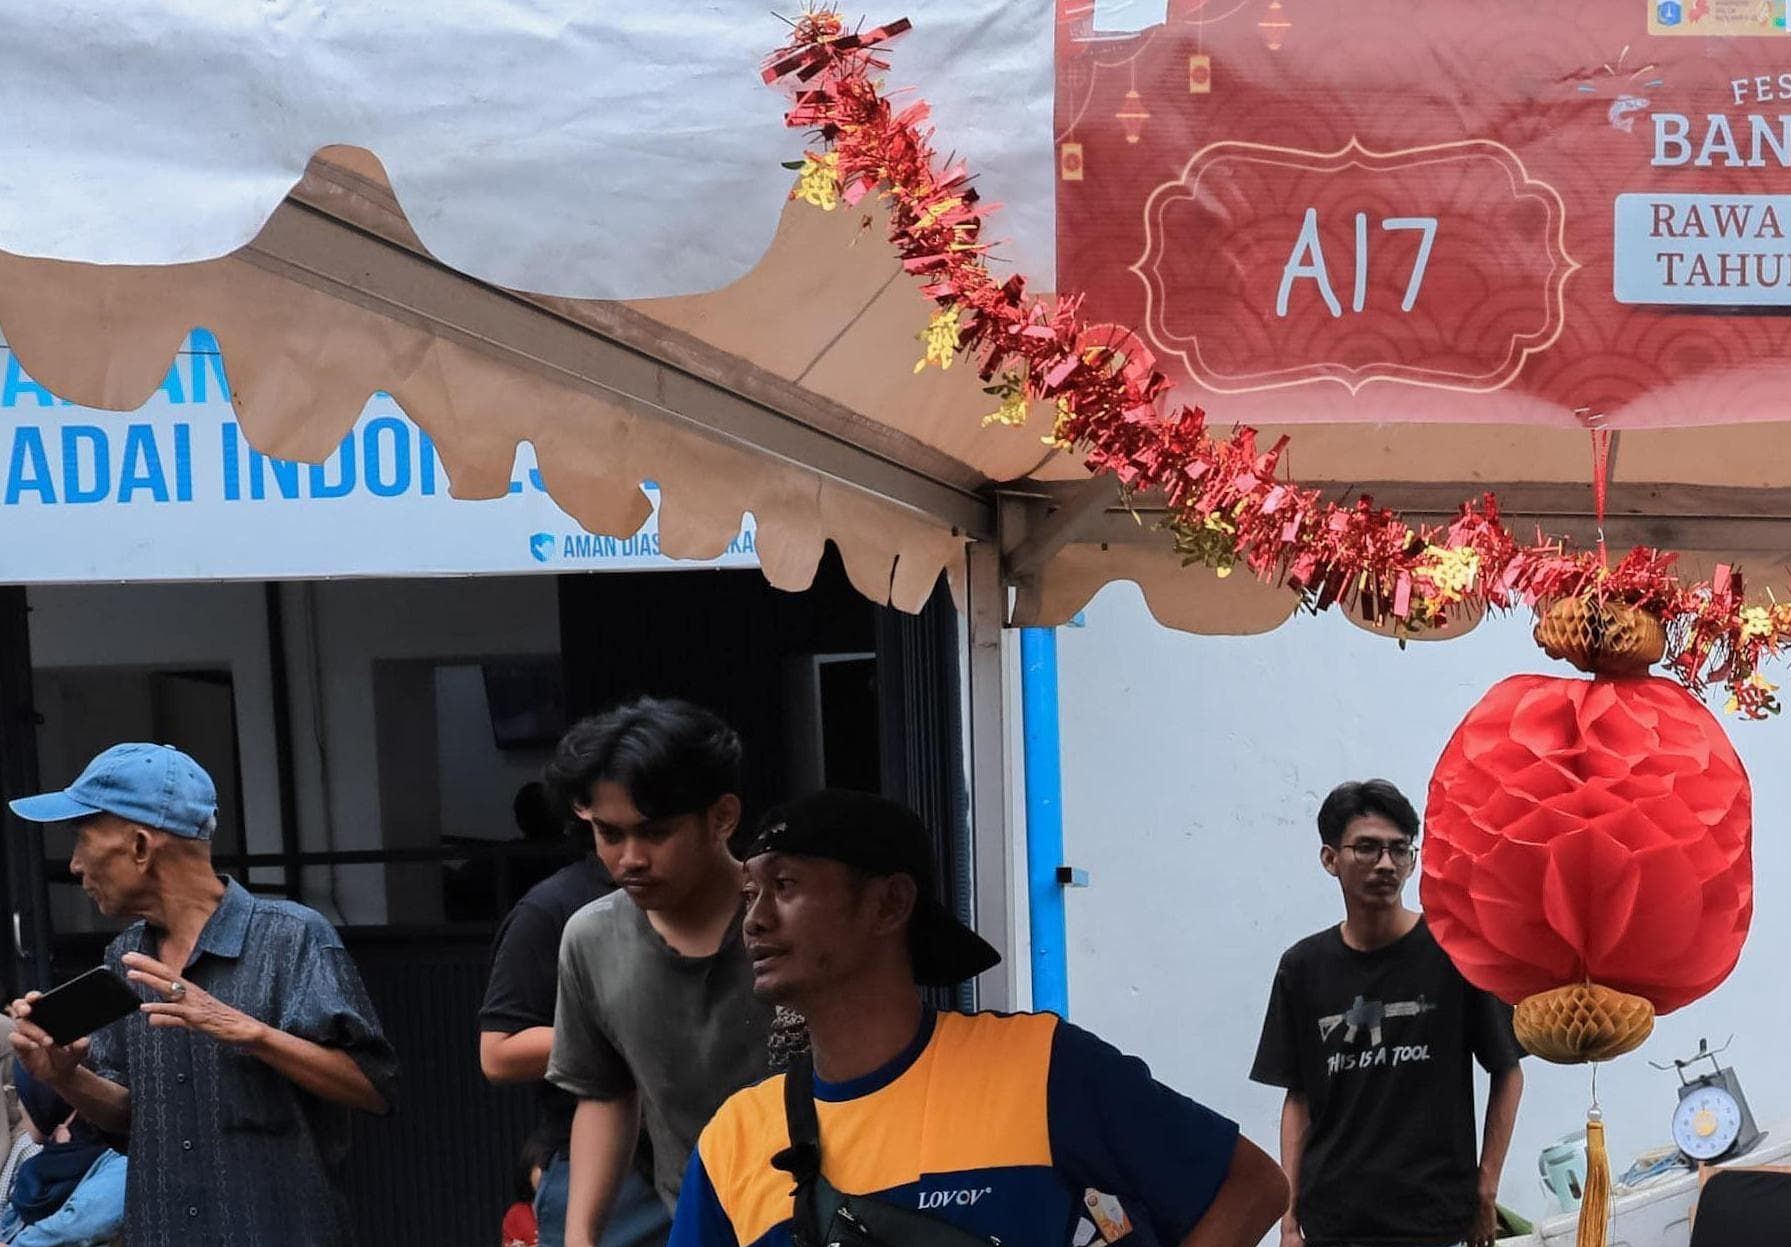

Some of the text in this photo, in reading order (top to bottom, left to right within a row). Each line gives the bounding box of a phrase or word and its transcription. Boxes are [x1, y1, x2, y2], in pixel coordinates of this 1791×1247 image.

[1649, 203, 1785, 239] RAWA
[1276, 207, 1438, 317] A17
[5, 422, 192, 505] ADAI
[563, 533, 616, 558] AMAN
[1359, 1051, 1373, 1068] IS
[1374, 1047, 1387, 1065] A
[1392, 1045, 1430, 1067] TOOL
